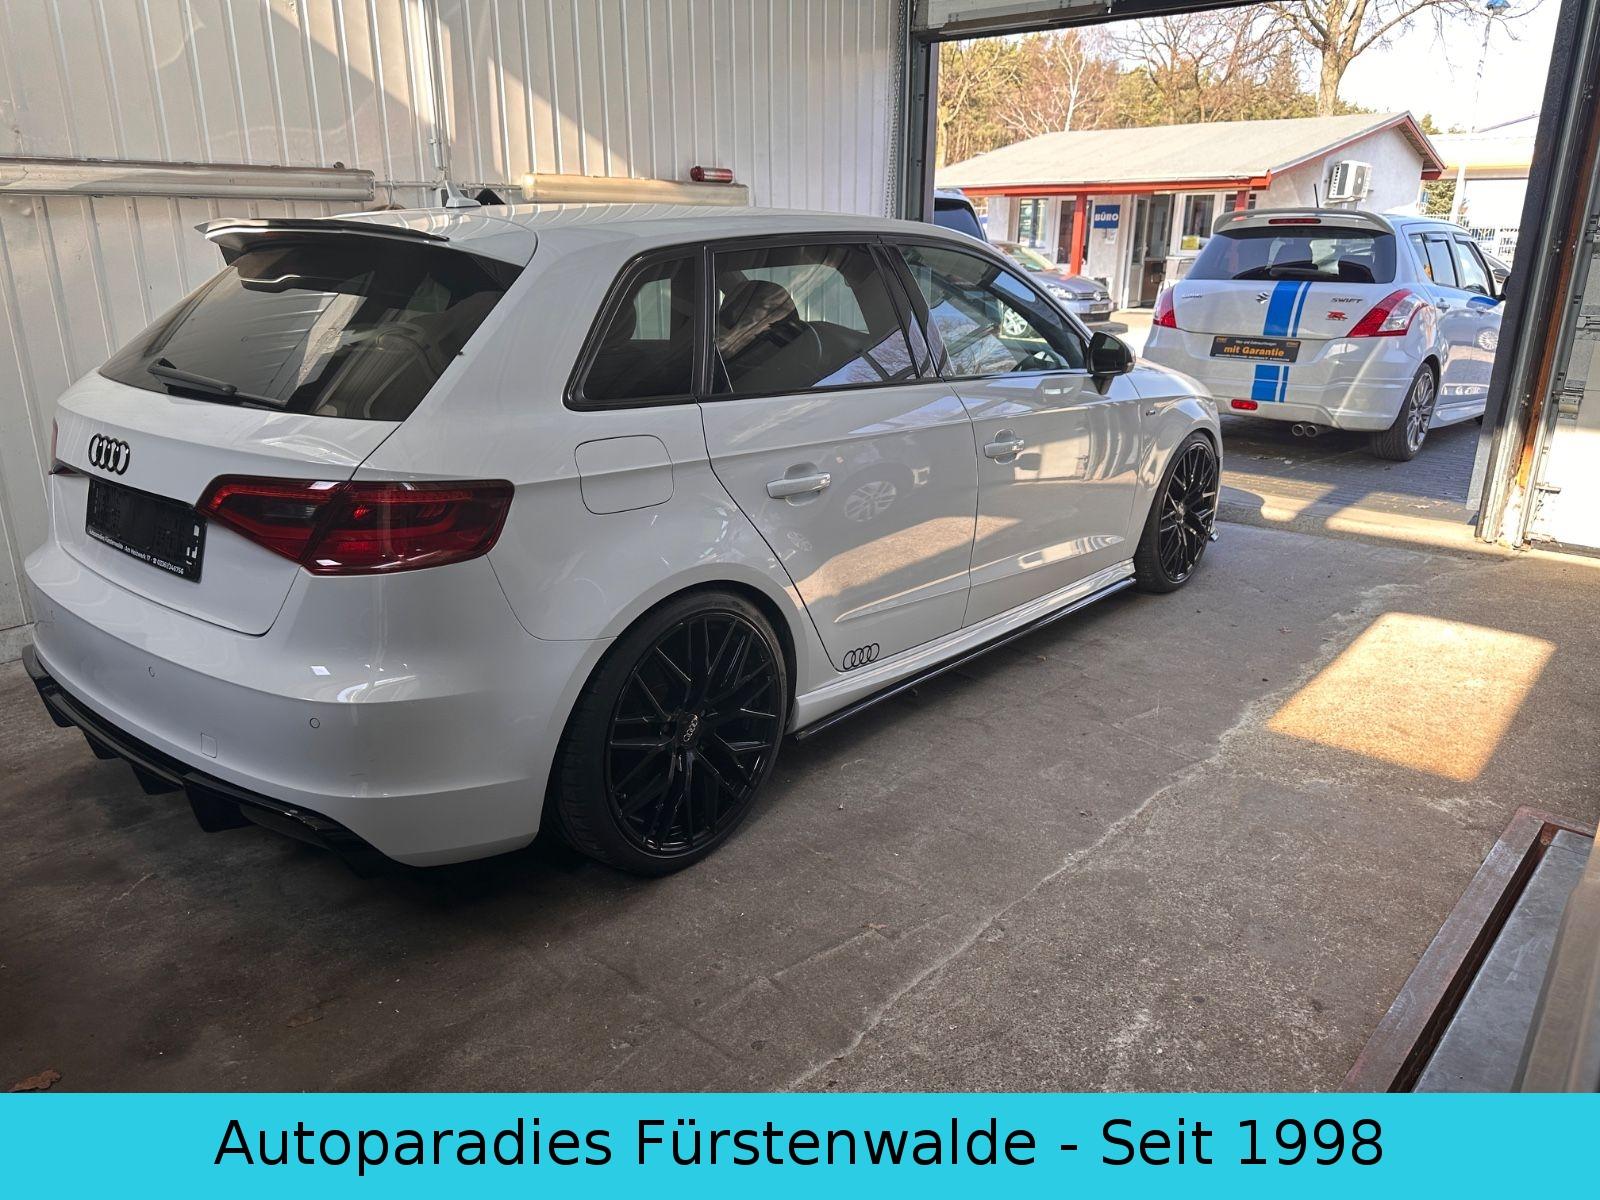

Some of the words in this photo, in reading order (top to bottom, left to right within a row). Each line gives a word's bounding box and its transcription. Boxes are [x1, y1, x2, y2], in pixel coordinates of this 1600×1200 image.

[1095, 211, 1118, 221] BÜRO
[1224, 345, 1240, 354] mit
[1242, 346, 1285, 357] Garantie
